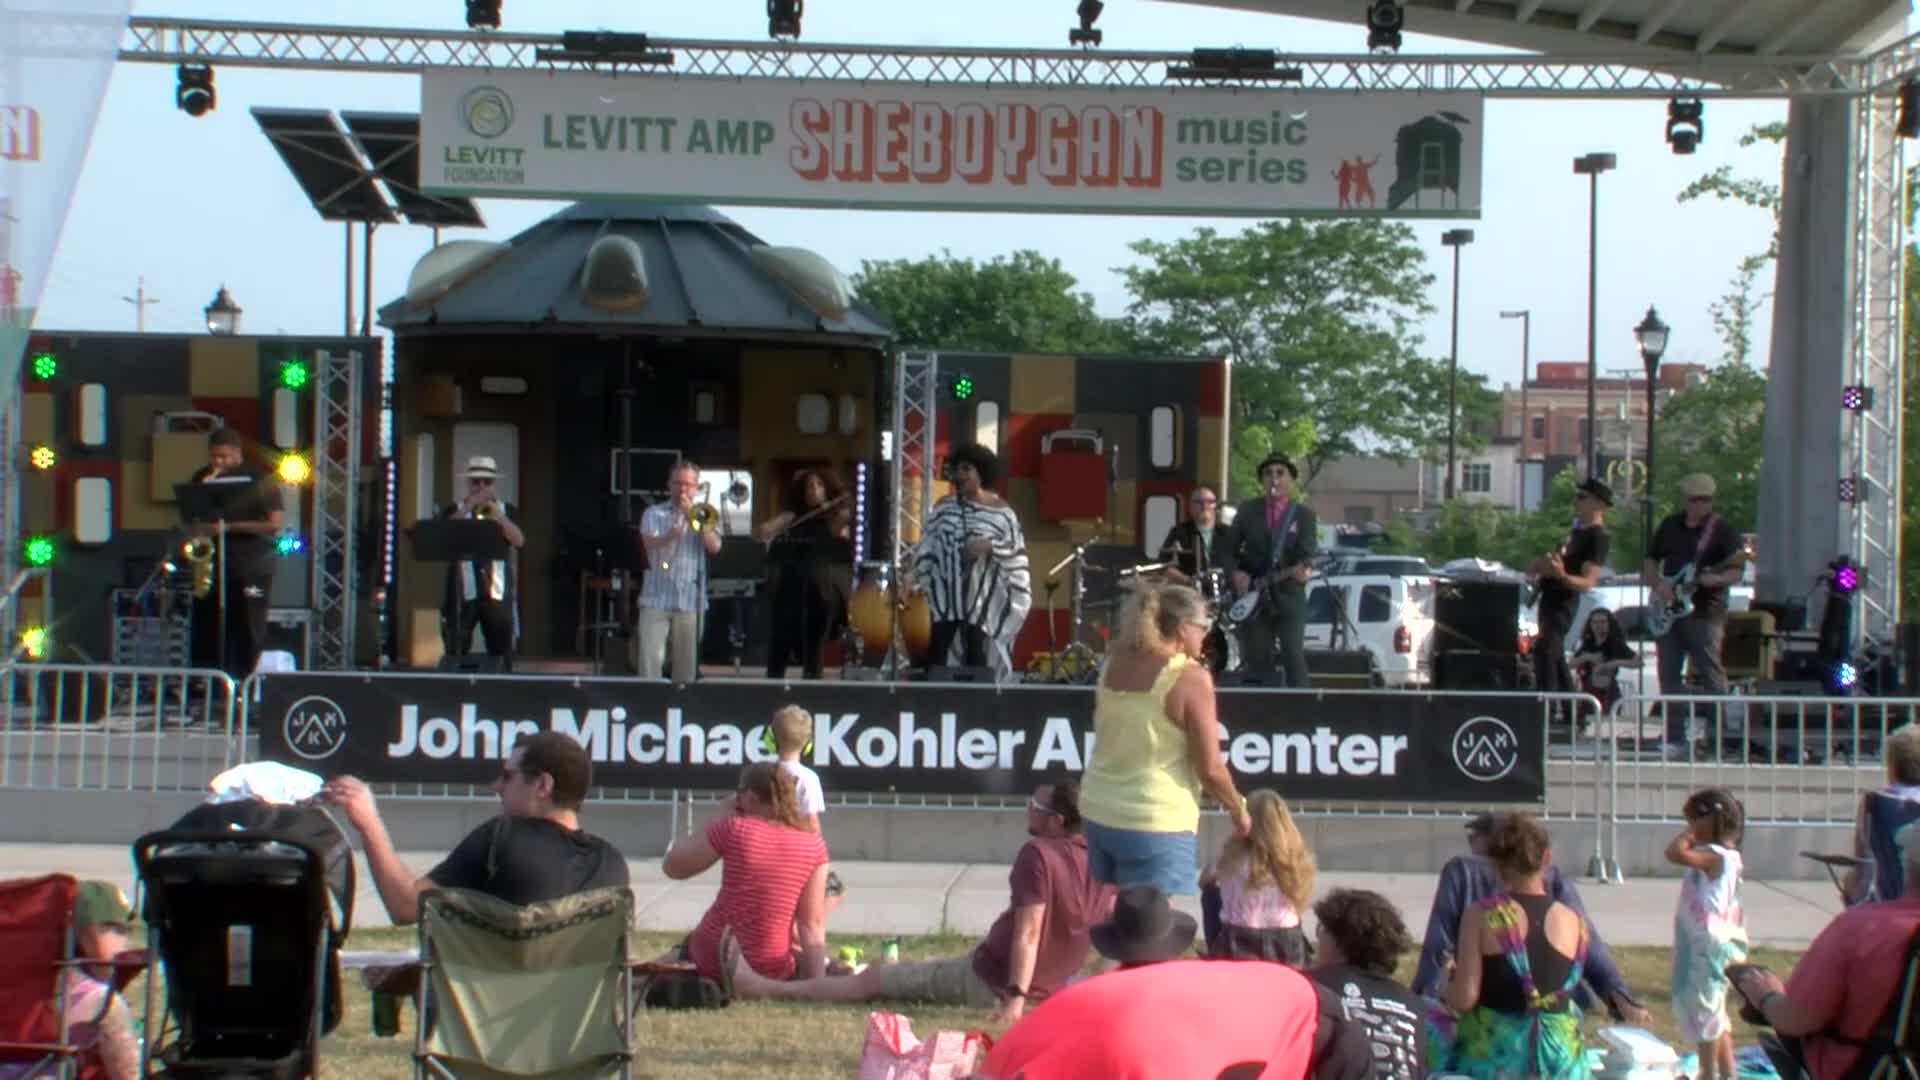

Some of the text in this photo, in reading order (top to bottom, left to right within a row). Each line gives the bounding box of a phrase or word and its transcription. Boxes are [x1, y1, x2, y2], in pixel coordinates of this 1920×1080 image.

[544, 98, 1164, 188] LEVITT AMP SHEBOYGAN
[1176, 110, 1308, 146] music
[444, 146, 526, 165] LEVITT
[1176, 150, 1308, 184] series
[552, 706, 779, 765] Michae
[814, 712, 1026, 770] Kohler
